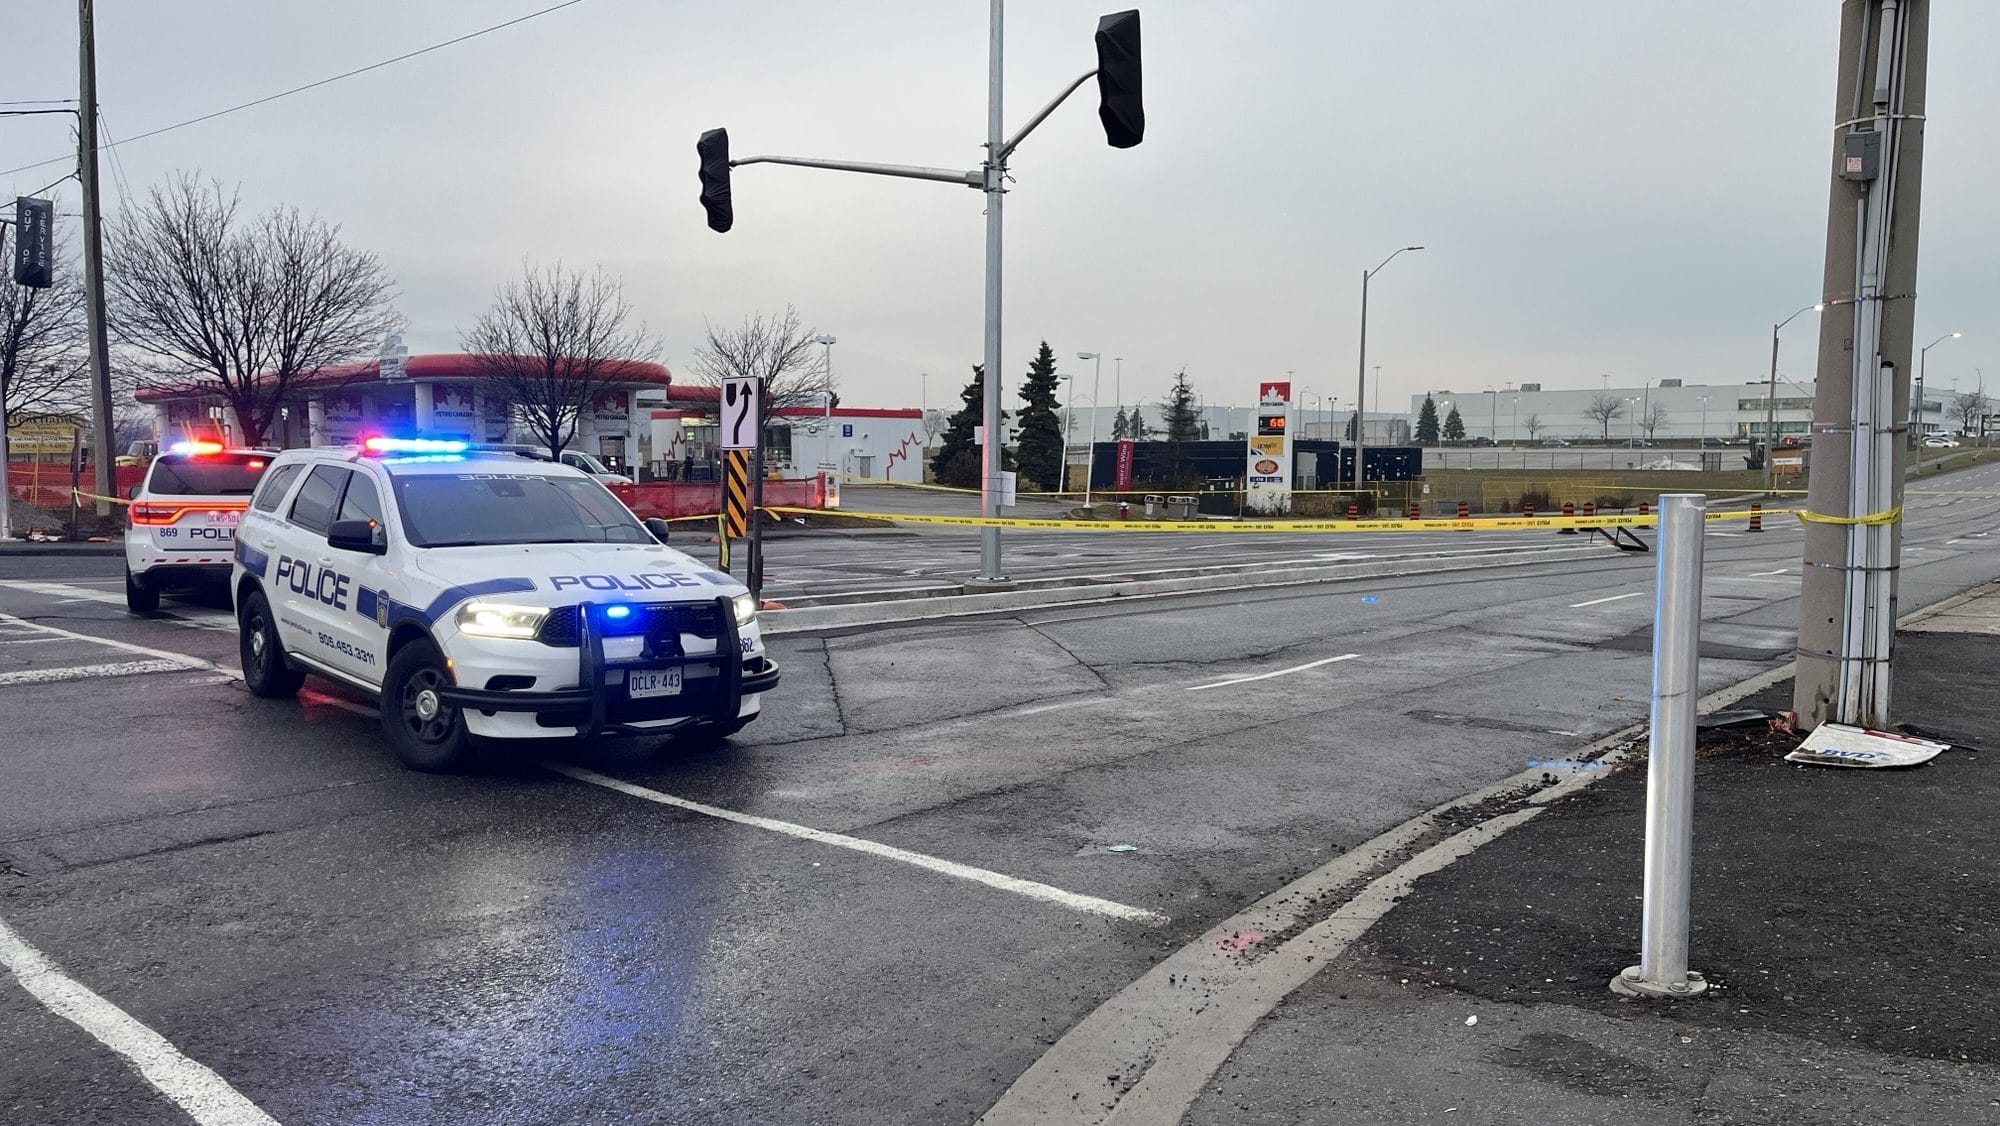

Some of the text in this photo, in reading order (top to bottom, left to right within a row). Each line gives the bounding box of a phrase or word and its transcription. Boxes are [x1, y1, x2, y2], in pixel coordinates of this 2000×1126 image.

[22, 209, 32, 265] OUT OF
[38, 211, 47, 268] SERVICE
[159, 527, 178, 537] 869
[275, 554, 351, 612] POLICE
[549, 573, 702, 591] POLICE
[317, 632, 376, 666] 905.453.3311
